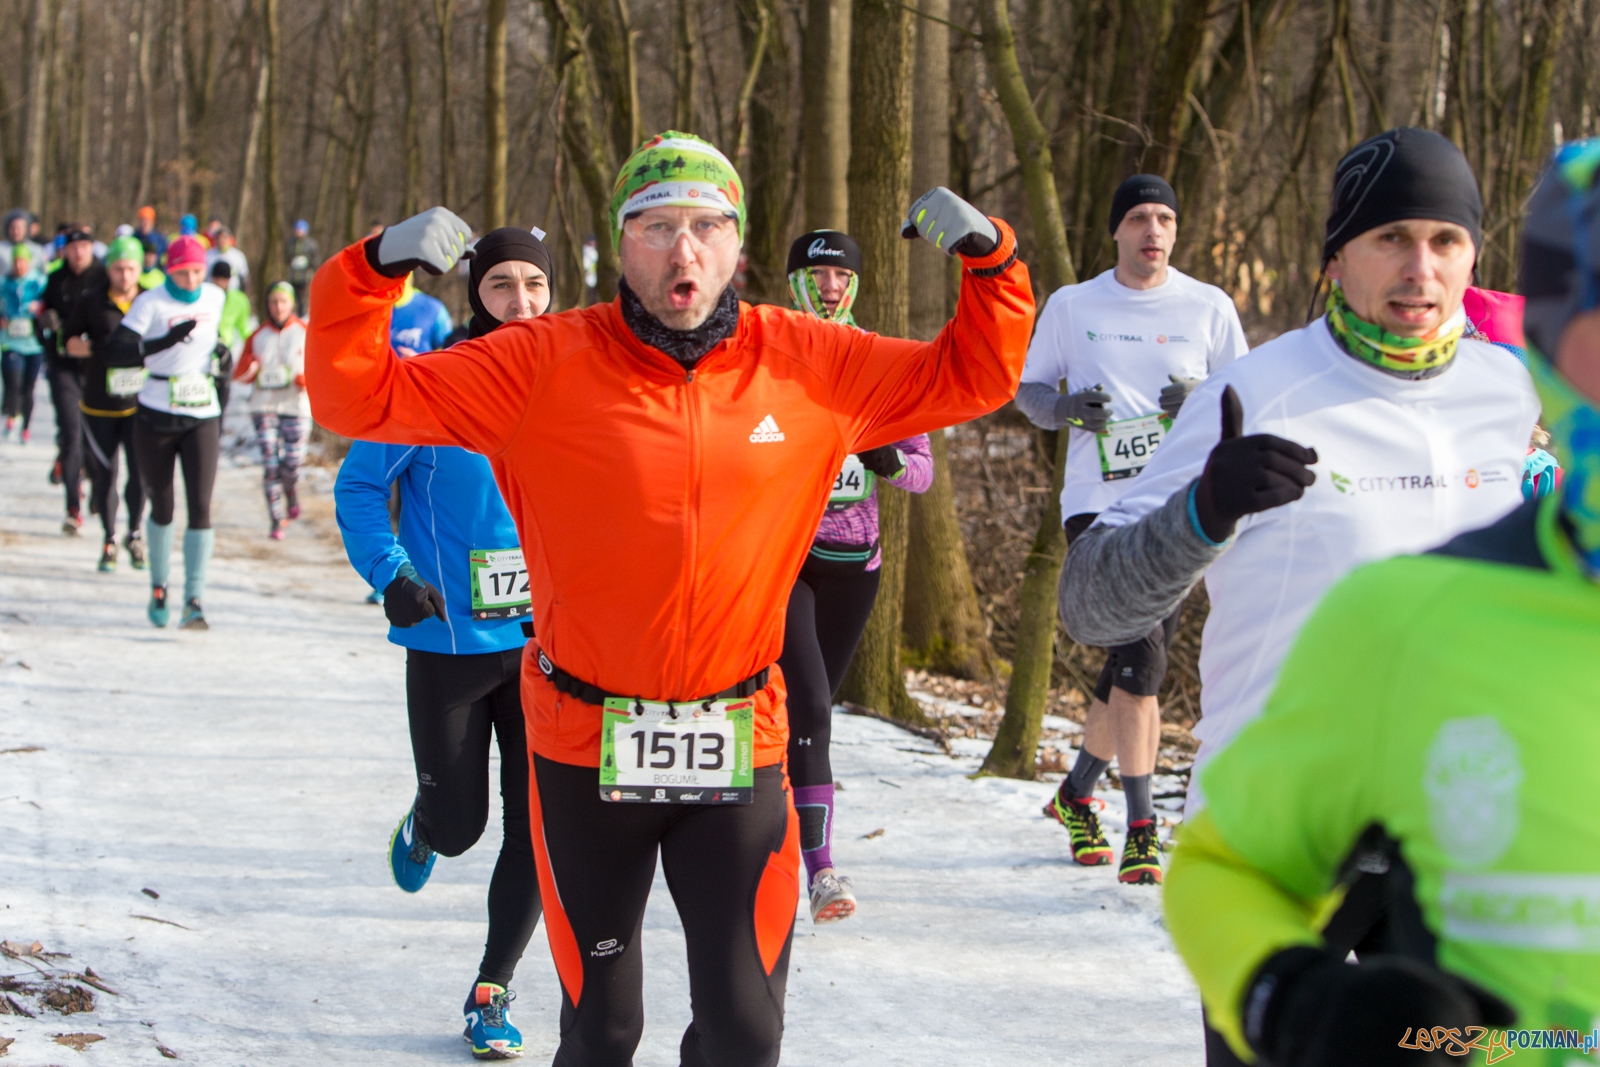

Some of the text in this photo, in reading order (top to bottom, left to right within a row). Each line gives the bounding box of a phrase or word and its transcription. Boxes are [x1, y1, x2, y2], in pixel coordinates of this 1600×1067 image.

[749, 432, 786, 443] adidas
[1115, 432, 1160, 459] 465
[630, 730, 725, 770] 1513
